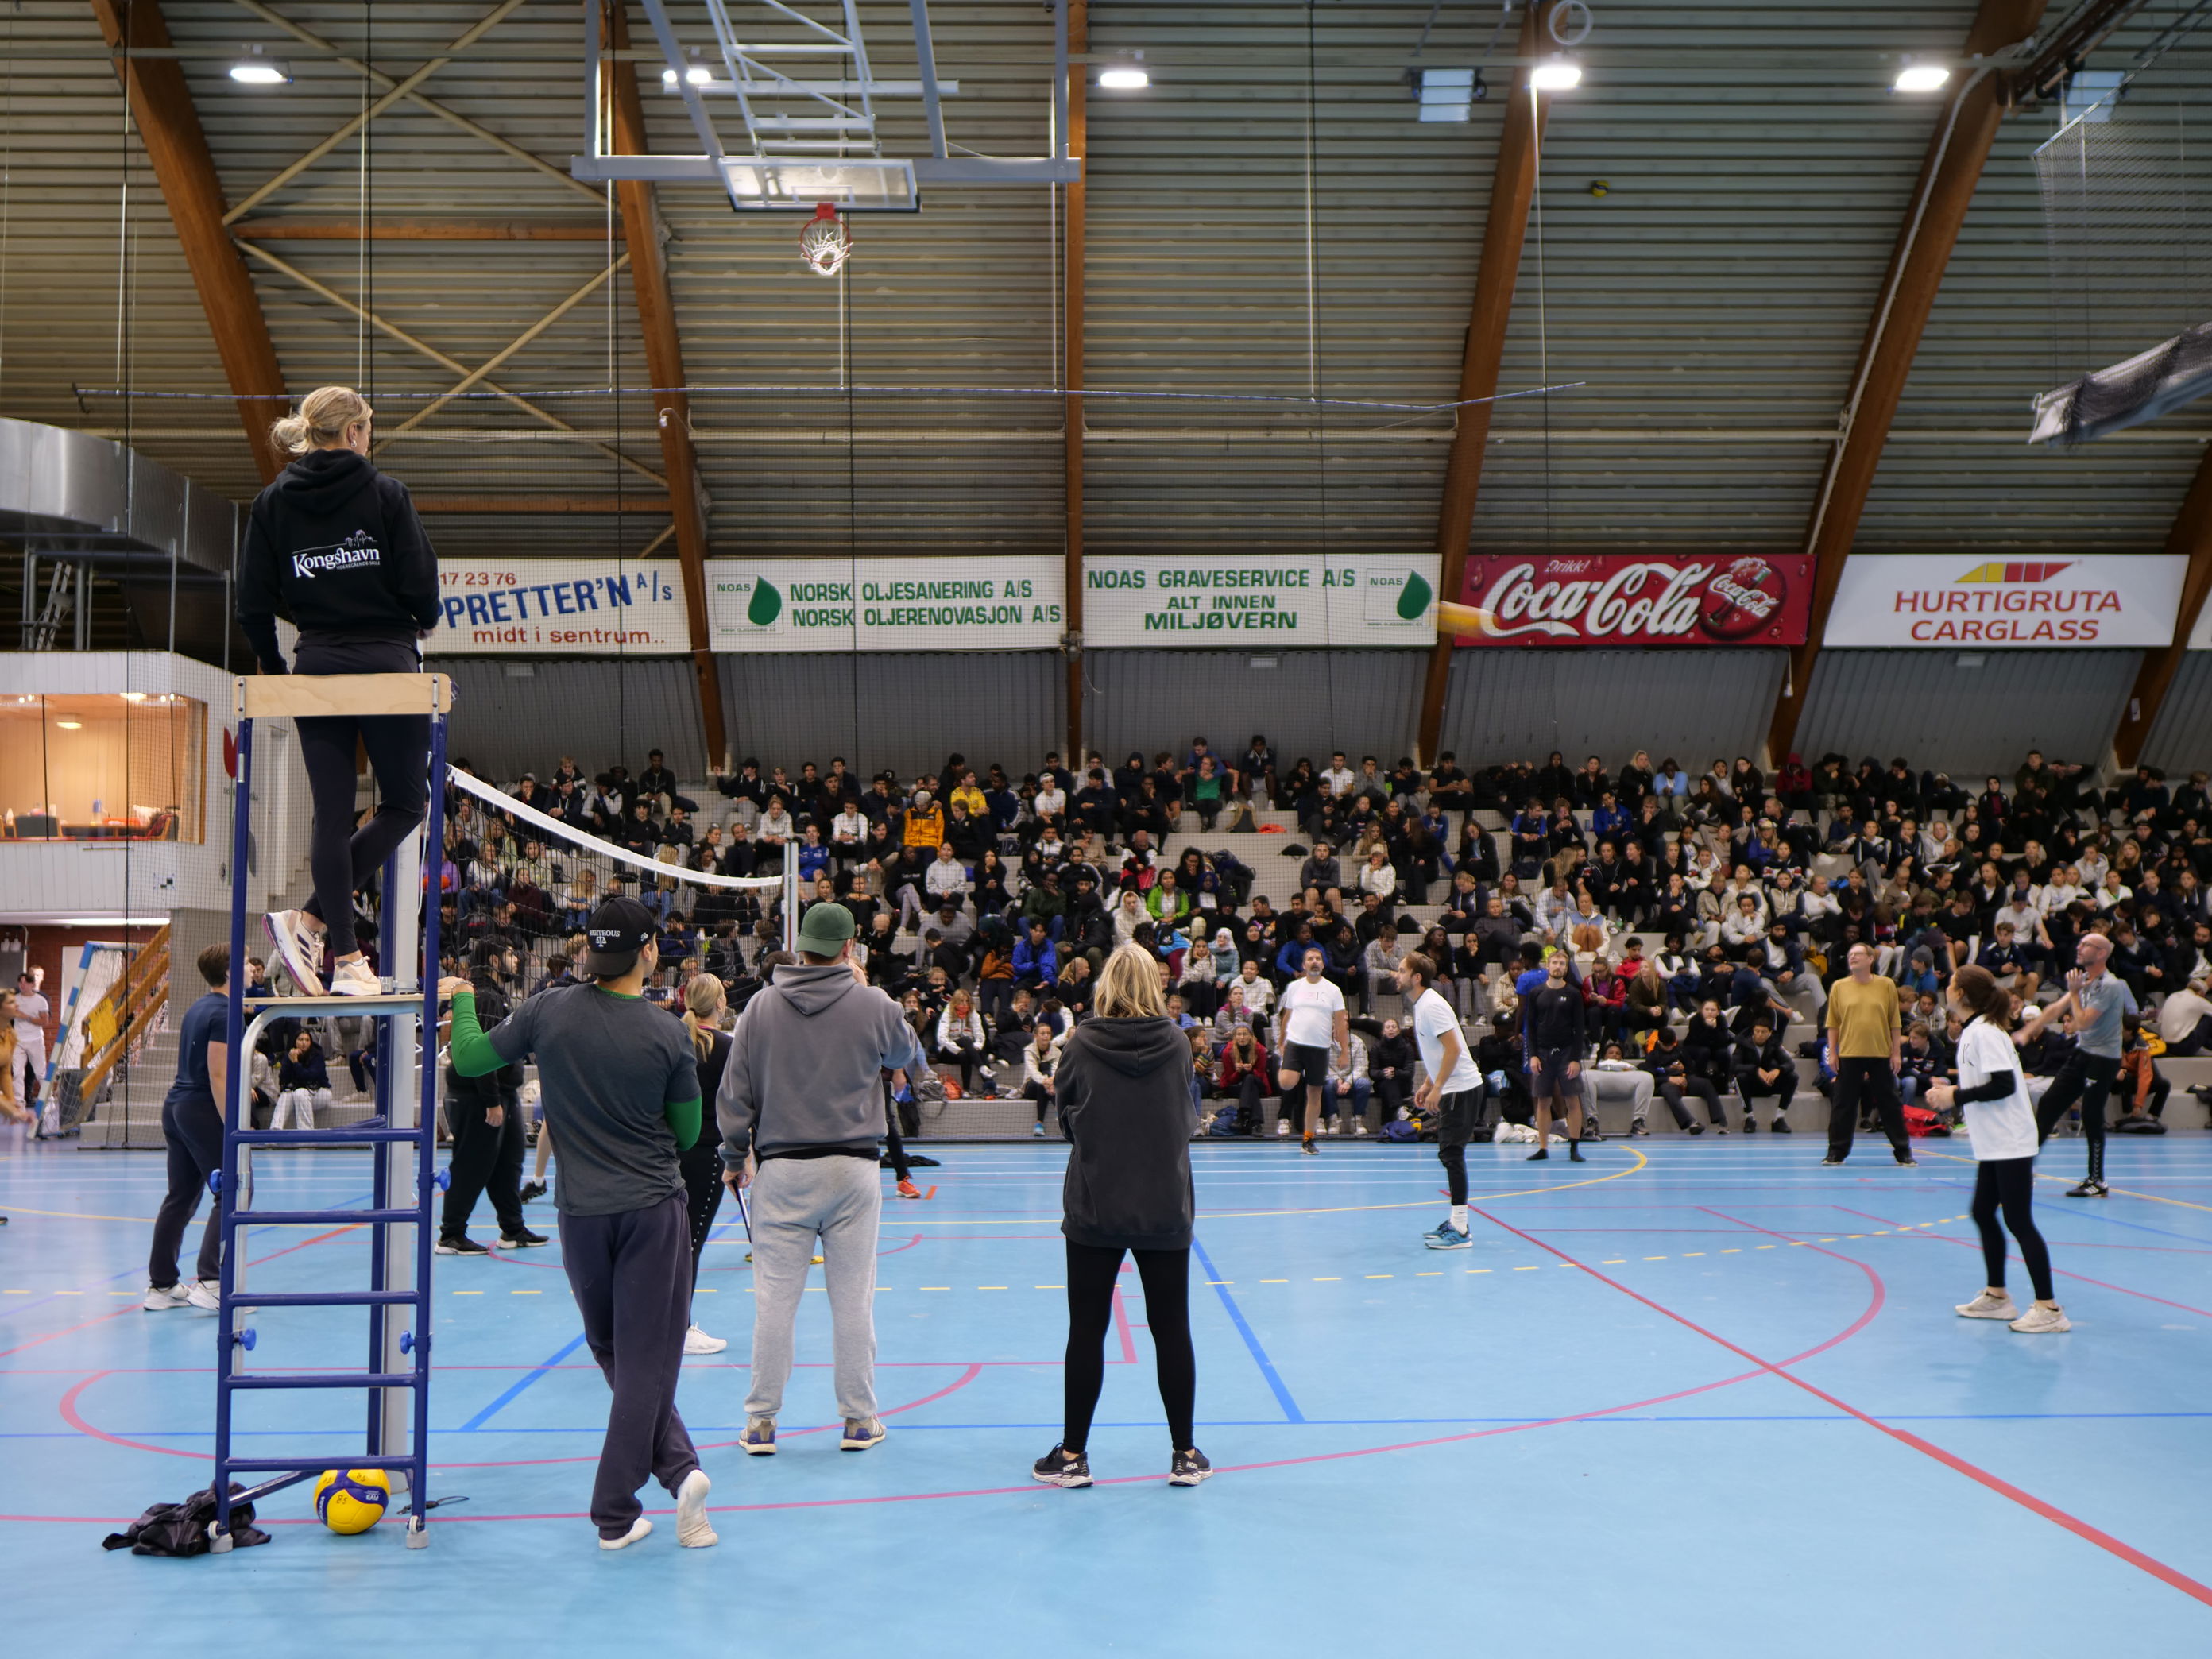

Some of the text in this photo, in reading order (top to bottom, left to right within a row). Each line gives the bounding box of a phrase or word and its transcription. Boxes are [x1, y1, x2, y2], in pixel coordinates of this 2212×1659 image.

[292, 547, 381, 578] Kongshavn
[1545, 559, 1591, 573] Drikk!
[717, 583, 752, 592] NOAS
[1088, 568, 1356, 589] NOAS GRAVESERVICE A/S
[438, 574, 632, 628] PRETTER'N
[790, 579, 1033, 601] NORSK OLJESANERING A/S
[1479, 562, 1716, 638] Coca-Cola
[1709, 574, 1780, 617] Coca-Cola
[1166, 595, 1276, 610] ALT INNEN
[1893, 590, 2122, 613] HURTIGRUTA
[792, 605, 1061, 627] NORSK OLJERENOVASJON A/S
[1144, 611, 1297, 630] MILJØVERN
[473, 626, 527, 643] midt
[535, 626, 540, 643] i
[1910, 619, 2099, 641] CARGLASS
[1063, 1462, 1078, 1472] HOKA
